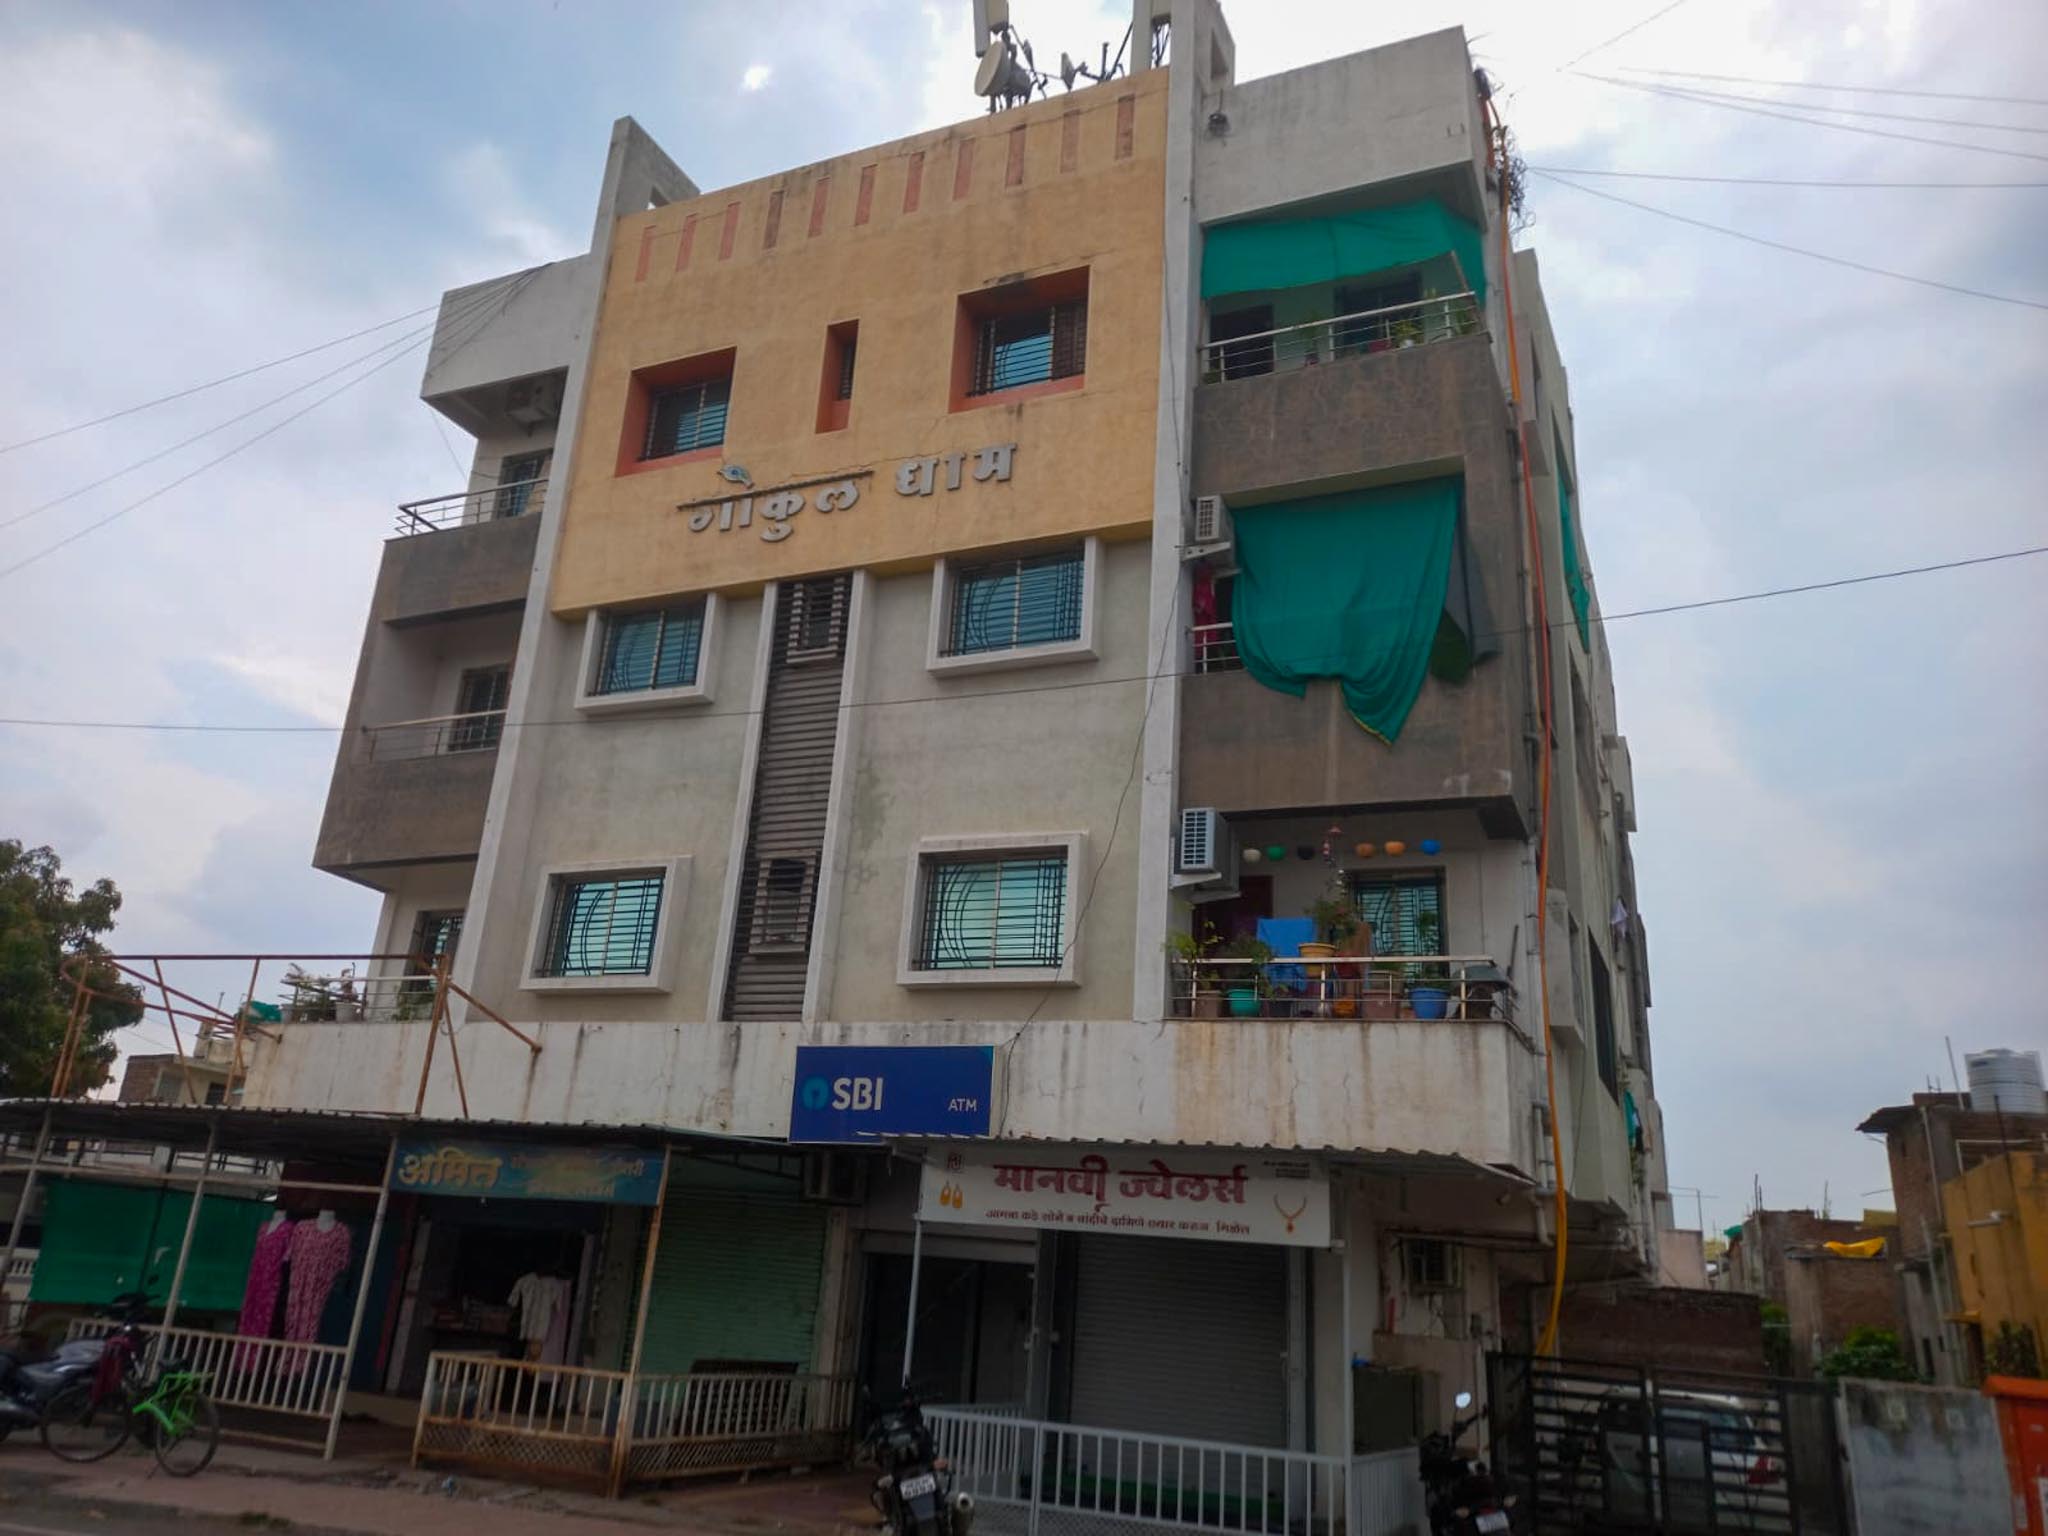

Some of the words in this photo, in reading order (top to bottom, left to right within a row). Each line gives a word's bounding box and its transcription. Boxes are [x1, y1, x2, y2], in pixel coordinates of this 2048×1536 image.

[677, 464, 874, 542] गोकुल
[895, 443, 1016, 496] धाम
[832, 1077, 884, 1110] SBI
[948, 1098, 977, 1112] ATM
[398, 1146, 503, 1188] अमित
[993, 1155, 1111, 1210] मानवी
[1119, 1159, 1249, 1204] ज्वेलर्स
